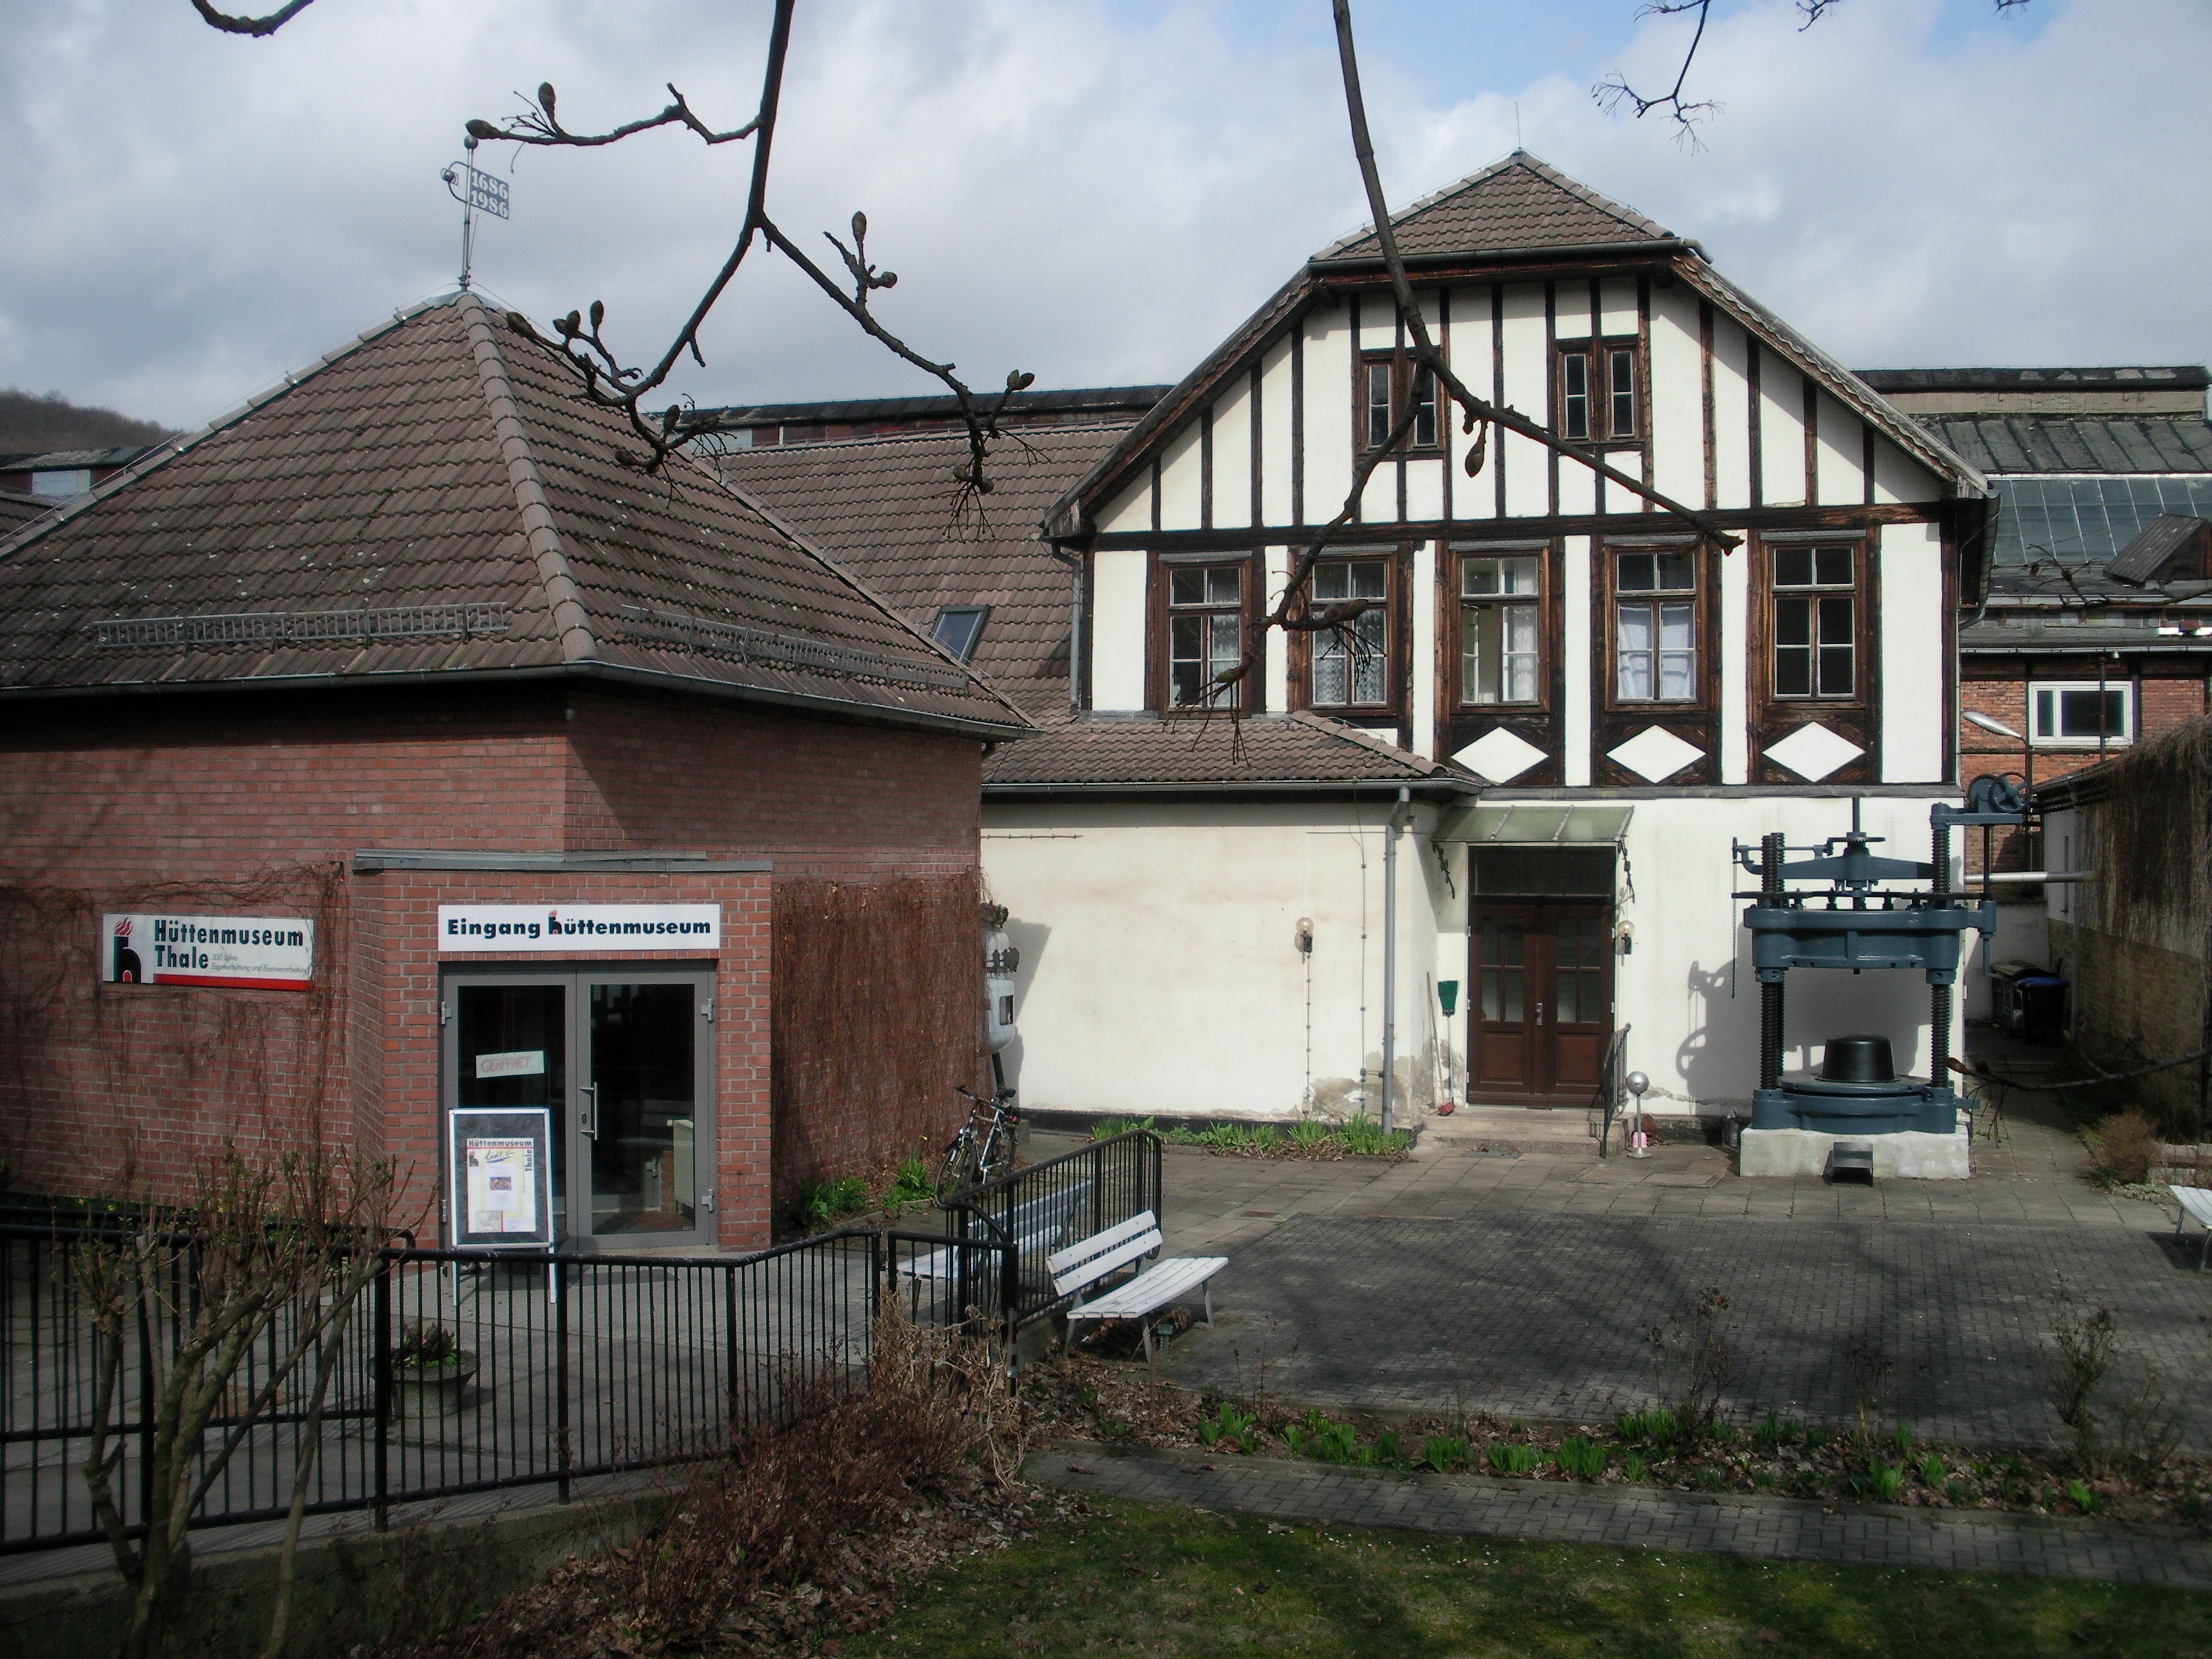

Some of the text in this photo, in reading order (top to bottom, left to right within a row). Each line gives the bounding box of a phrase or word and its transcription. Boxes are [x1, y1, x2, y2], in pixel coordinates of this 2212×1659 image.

[155, 919, 303, 947] Hüttenmuseum
[447, 917, 540, 939] Eingang
[155, 945, 209, 968] Thale
